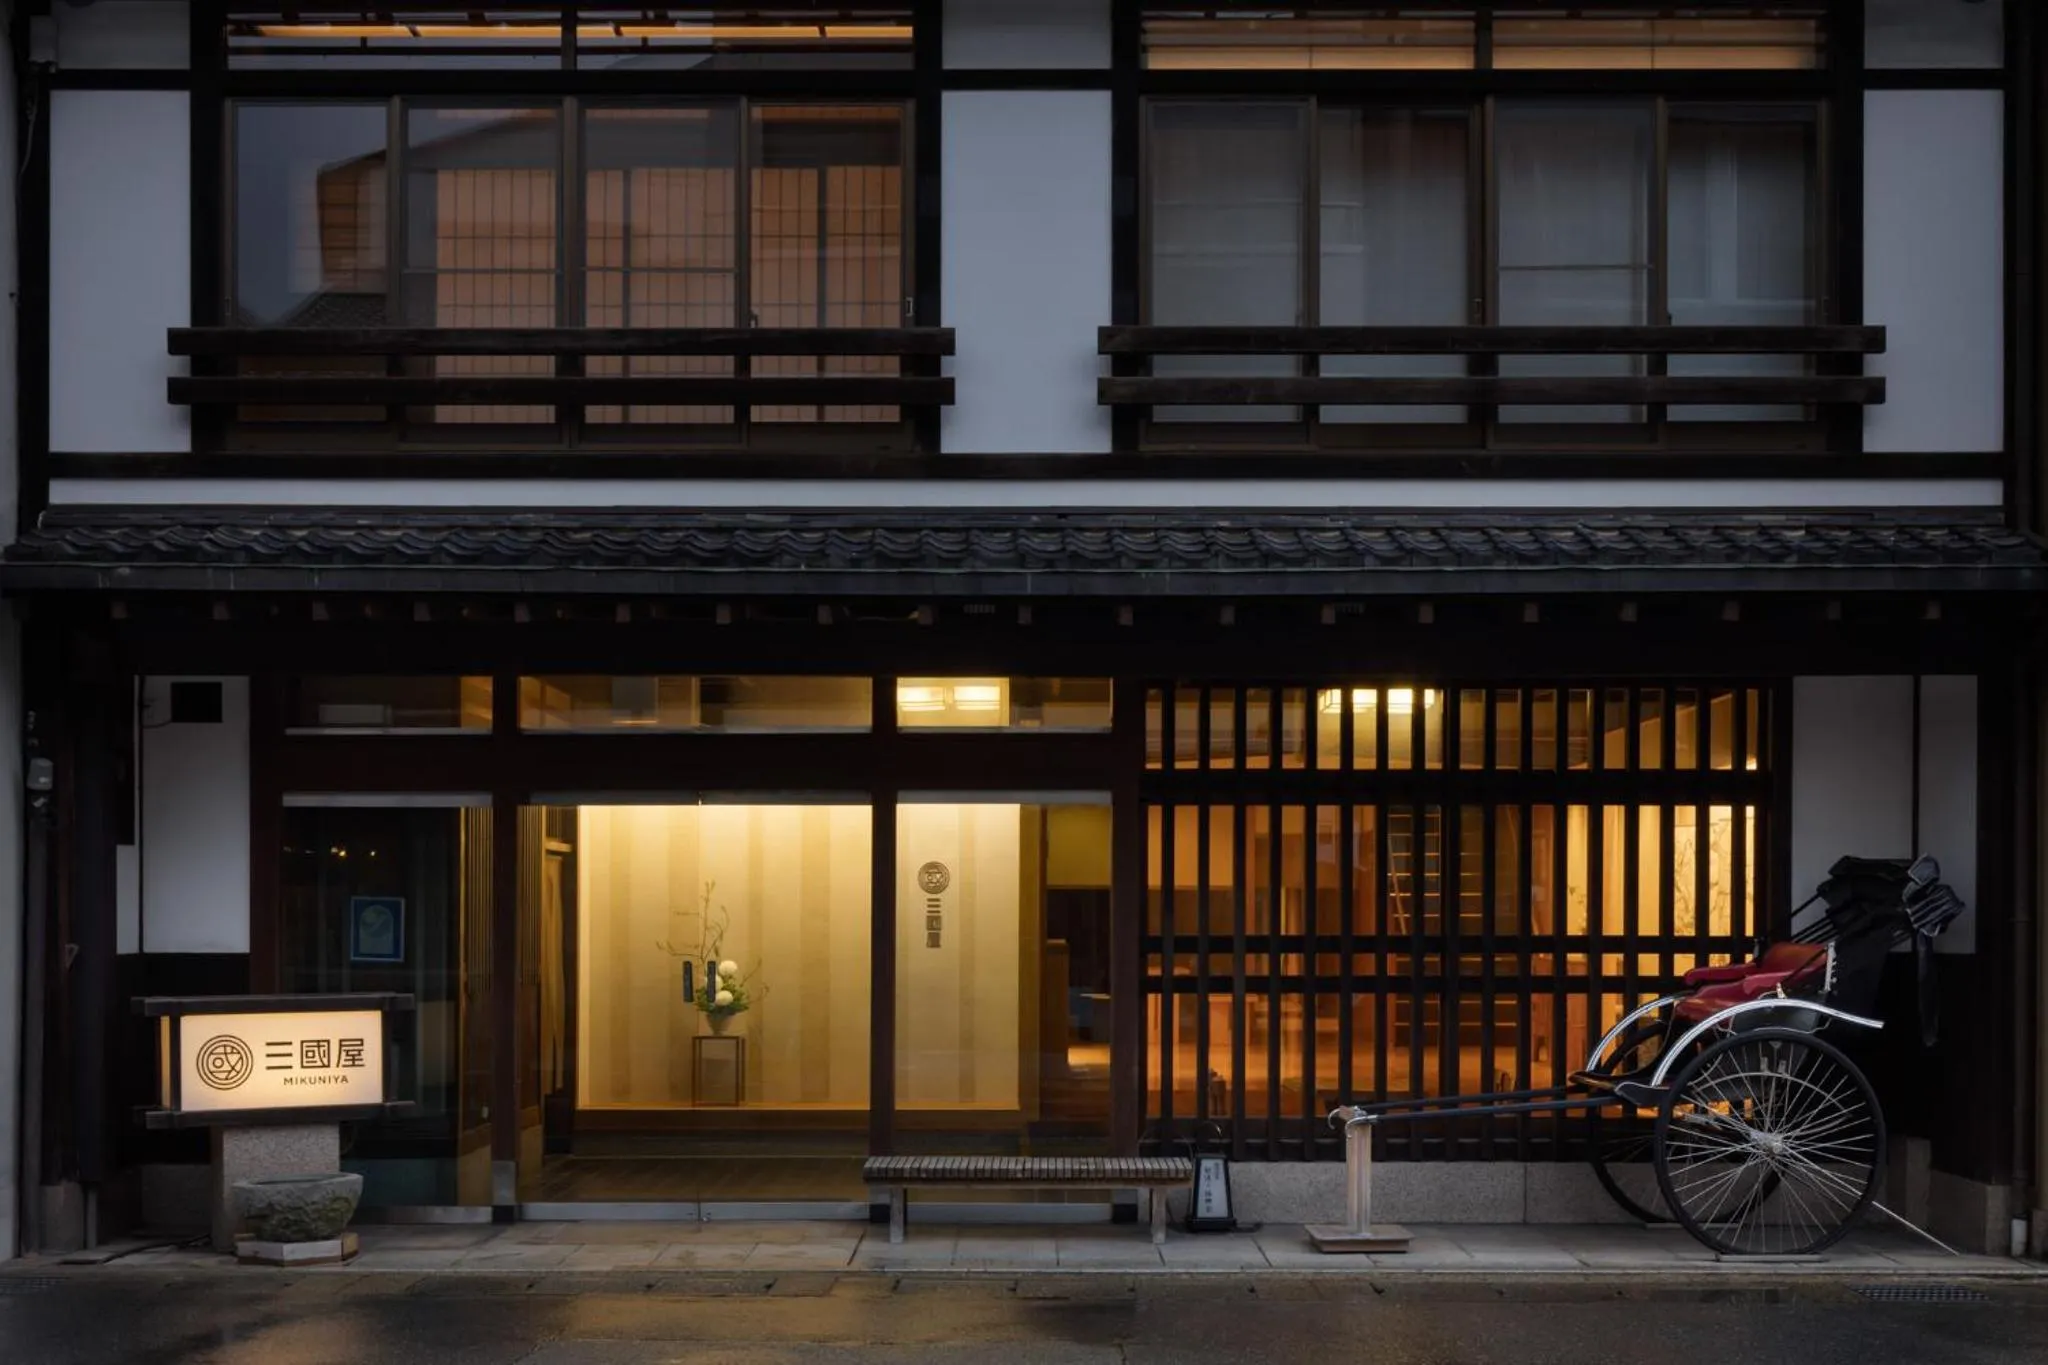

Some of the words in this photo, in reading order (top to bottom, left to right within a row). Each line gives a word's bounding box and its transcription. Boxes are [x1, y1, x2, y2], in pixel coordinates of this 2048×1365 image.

[265, 1038, 365, 1070] 三國屋
[283, 1075, 349, 1085] MIKUNIYA
